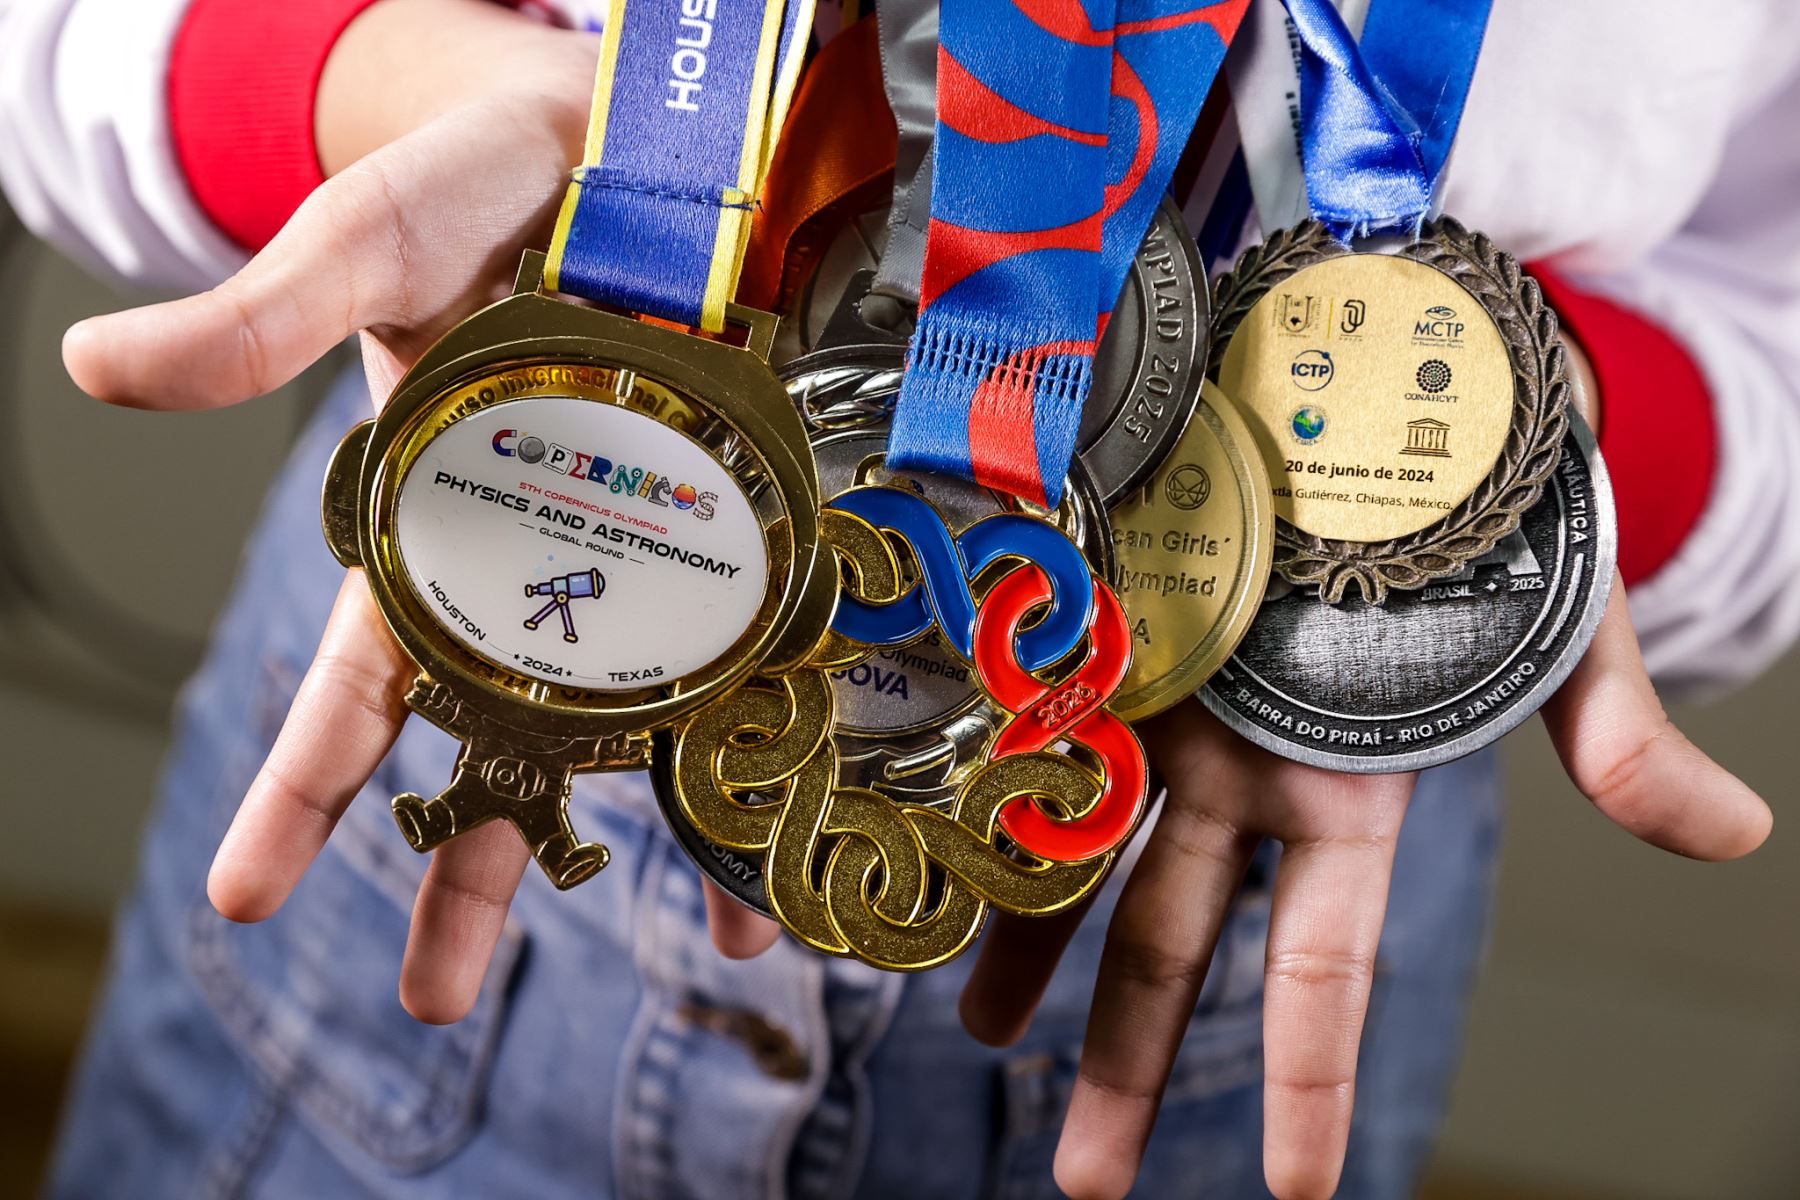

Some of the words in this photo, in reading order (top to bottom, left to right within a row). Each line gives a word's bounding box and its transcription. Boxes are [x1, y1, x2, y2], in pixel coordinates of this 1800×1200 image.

[1414, 320, 1465, 337] MCTP
[1291, 362, 1330, 378] ICTP
[1124, 353, 1180, 444] 2025
[1404, 393, 1459, 403] CONAHCYT
[1284, 460, 1303, 473] 20
[1307, 461, 1327, 475] de
[1328, 463, 1370, 478] junio
[1374, 466, 1393, 480] de
[1397, 468, 1435, 483] 2024
[518, 481, 542, 495] 5TH
[544, 490, 611, 517] COPERNICUS
[613, 512, 668, 535] OLYMPIAD
[1295, 488, 1352, 503] Gutiérrez,
[1355, 492, 1405, 507] Chiapas,
[1408, 497, 1454, 511] México.
[434, 470, 529, 512] PHYSICS
[535, 505, 586, 530] AND
[592, 523, 742, 580] ASTRONOMY
[1113, 528, 1153, 549] can
[539, 527, 583, 547] GLOBAL
[585, 540, 625, 561] ROUND
[1422, 584, 1475, 600] BRASIL
[1510, 576, 1545, 592] 2025
[427, 580, 487, 641] HOUSTON
[522, 655, 564, 677] 2024
[607, 665, 665, 682] TEXAS
[1037, 681, 1097, 728] 2026
[1236, 688, 1293, 729] BARRA
[1295, 721, 1325, 740] DO
[1329, 727, 1382, 746] PIRAÍ
[1399, 722, 1434, 743] RIO
[1437, 712, 1463, 732] DE
[1465, 661, 1537, 721] JANEIRO
[704, 836, 758, 880] OMY
